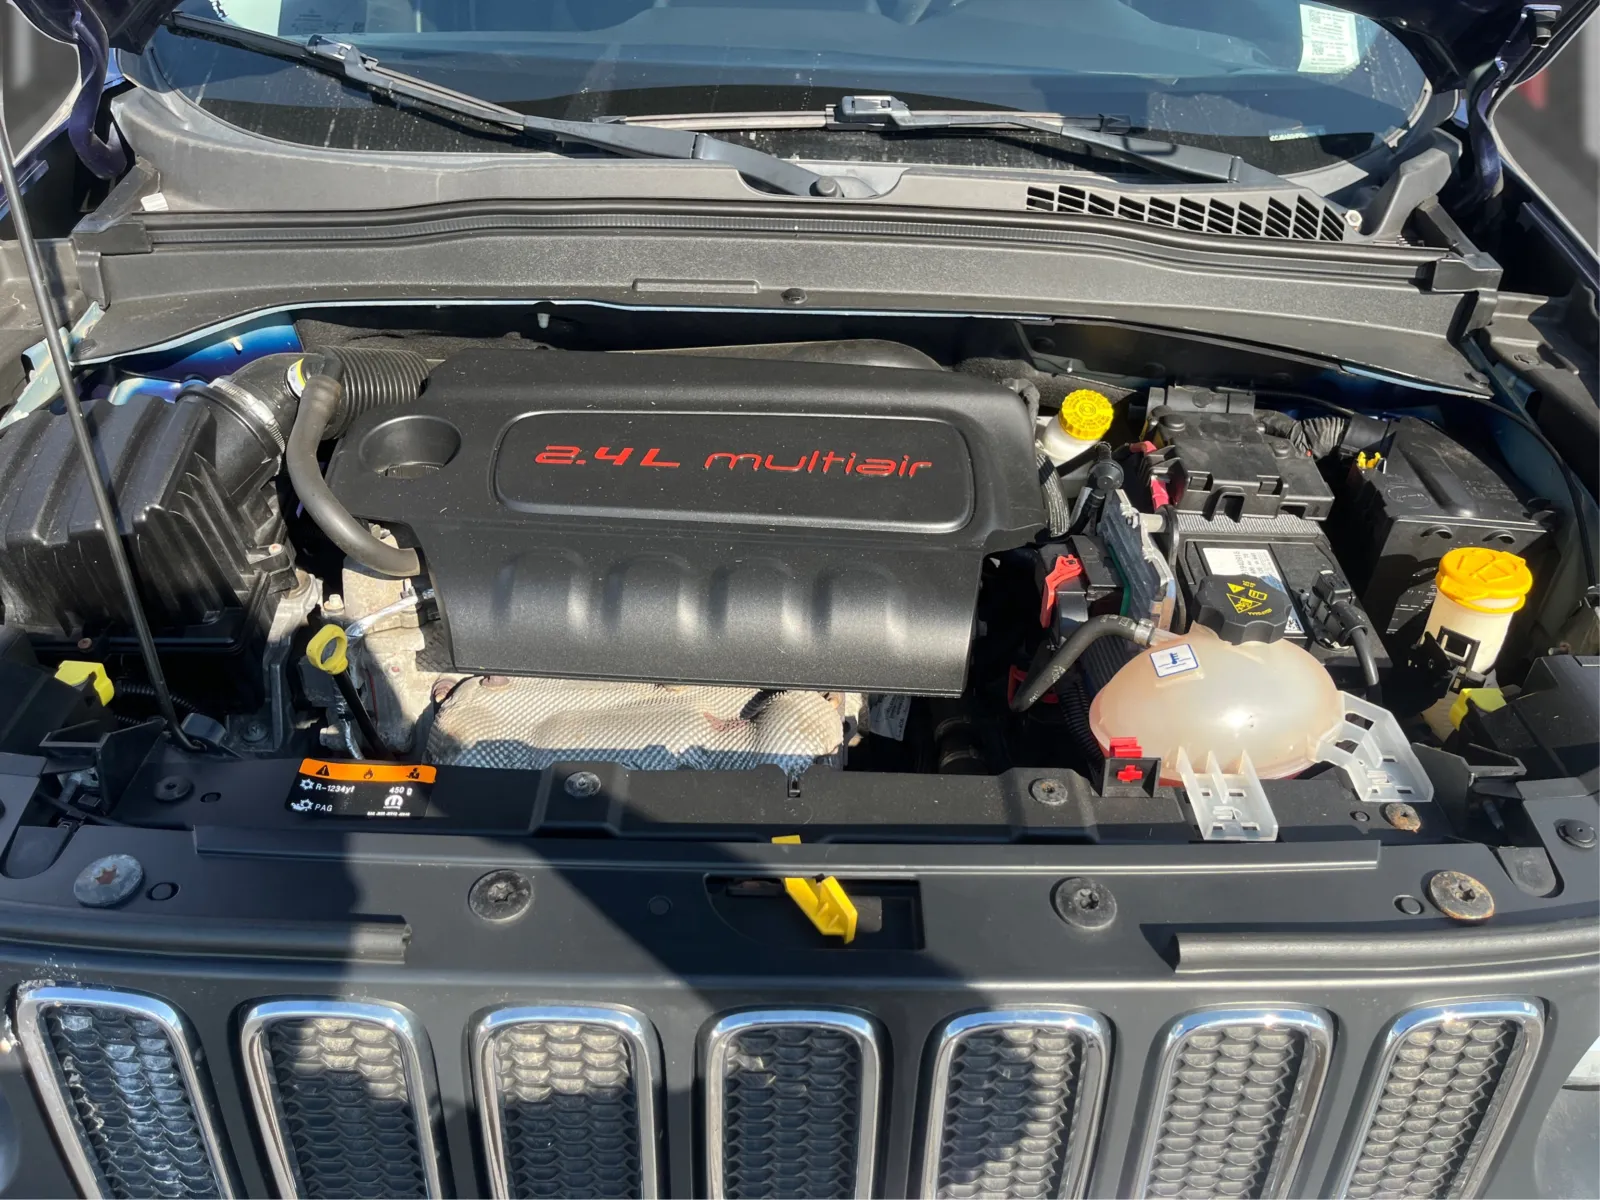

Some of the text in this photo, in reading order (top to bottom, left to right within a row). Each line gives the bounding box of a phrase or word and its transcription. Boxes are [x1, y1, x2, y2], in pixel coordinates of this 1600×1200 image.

[535, 445, 932, 478] 2.4L multiair
[315, 783, 355, 794] R-1234yf
[389, 786, 405, 794] 450
[314, 803, 333, 812] PAG
